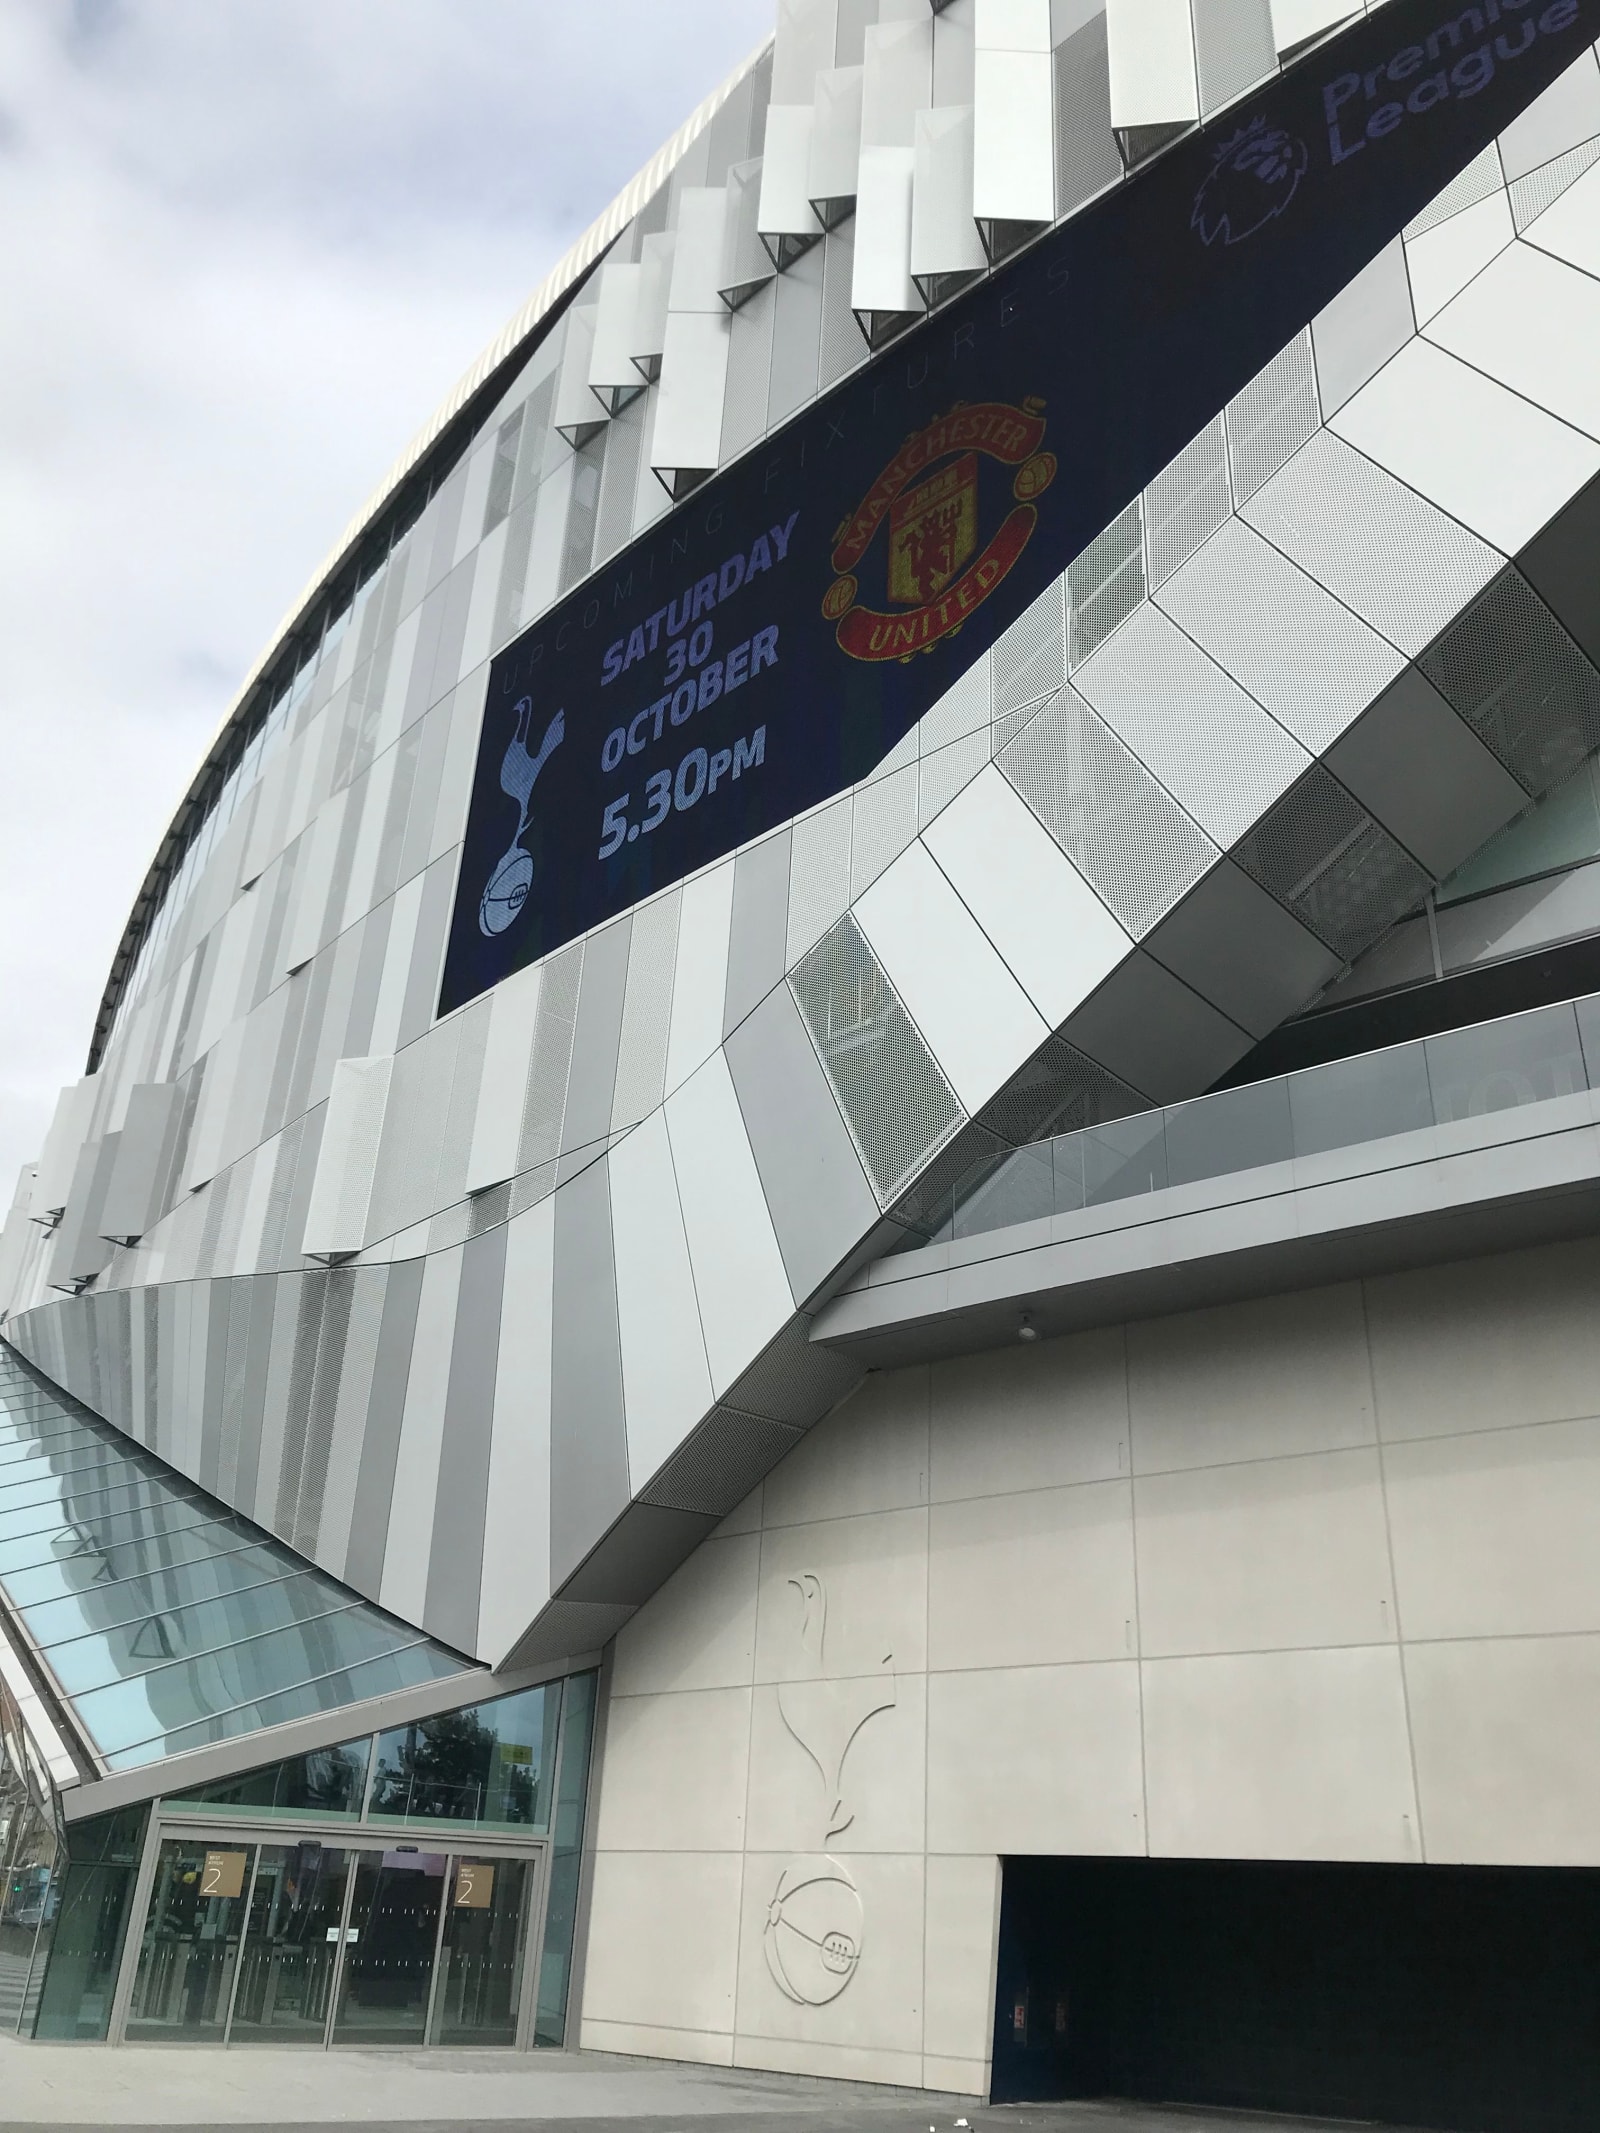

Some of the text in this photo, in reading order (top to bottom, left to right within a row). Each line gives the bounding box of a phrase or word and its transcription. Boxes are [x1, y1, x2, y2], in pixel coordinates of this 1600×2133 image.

[1321, 0, 1533, 124] Premi
[1326, 0, 1579, 166] League
[503, 256, 1069, 694] UPCOMING FIXTURES
[847, 413, 1028, 550] MANCHESTER
[601, 510, 800, 686] SATURDAY
[664, 620, 713, 686] 30
[870, 558, 999, 651] UNITED
[601, 625, 779, 773] OCTOBER
[598, 725, 767, 860] 5.30PM
[203, 1868, 221, 1893] 2
[457, 1880, 473, 1904] 2
